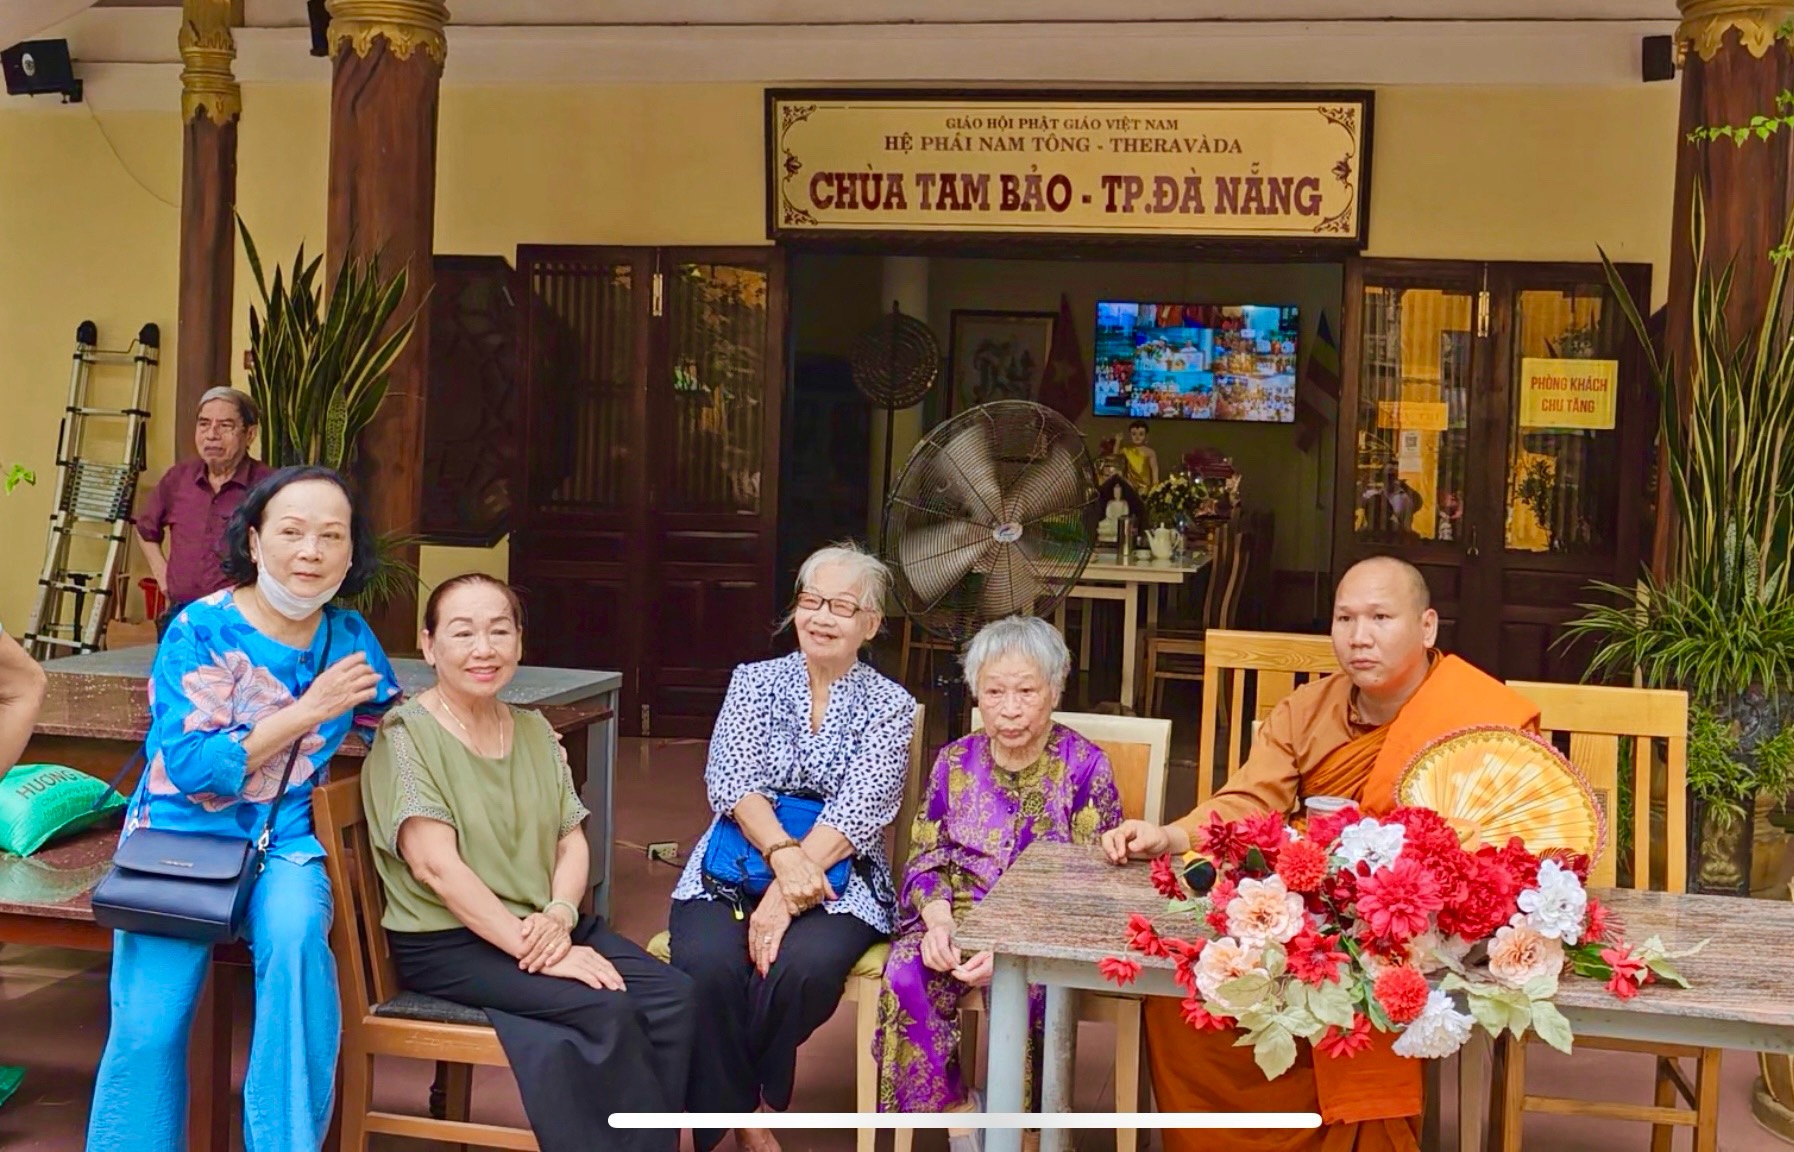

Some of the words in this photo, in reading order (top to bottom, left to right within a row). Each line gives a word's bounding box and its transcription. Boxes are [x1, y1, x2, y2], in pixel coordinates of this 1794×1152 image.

[945, 116, 983, 130] GIÁO
[987, 115, 1014, 132] HỘI
[1018, 115, 1060, 132] PHẬT
[1063, 116, 1101, 130] GIÁO
[1106, 116, 1142, 132] VIỆT
[1145, 118, 1179, 131] NAM
[884, 131, 913, 155] HỆ
[921, 132, 973, 151] PHÁI
[979, 136, 1025, 152] NAM
[1032, 133, 1090, 152] TÔNG
[1109, 133, 1243, 154] THERAVÀDA
[809, 163, 908, 210] CHÙA
[915, 173, 990, 211] TAM
[999, 164, 1073, 213] BẢO
[1082, 194, 1092, 204] -
[1101, 167, 1205, 214] TP.ĐÀ
[1214, 162, 1323, 216] NẴNG
[1531, 373, 1568, 391] PHÒNG
[1569, 375, 1608, 392] KHÁCH
